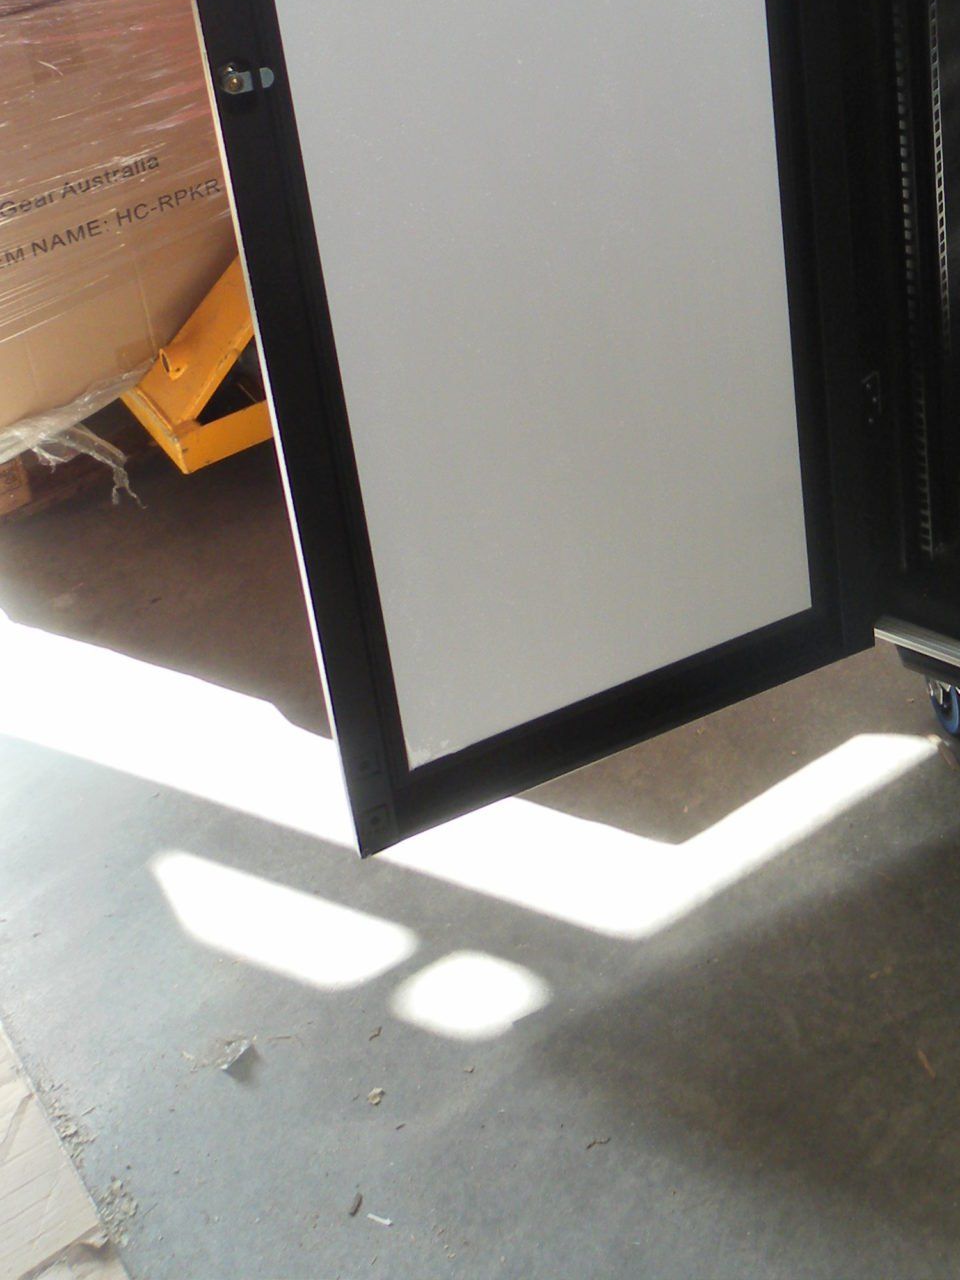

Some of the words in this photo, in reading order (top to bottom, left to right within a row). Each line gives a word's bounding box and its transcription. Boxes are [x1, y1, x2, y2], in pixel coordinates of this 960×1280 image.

[62, 156, 160, 199] Australia
[31, 219, 110, 256] NAME:
[116, 178, 221, 226] HC-RPKR
